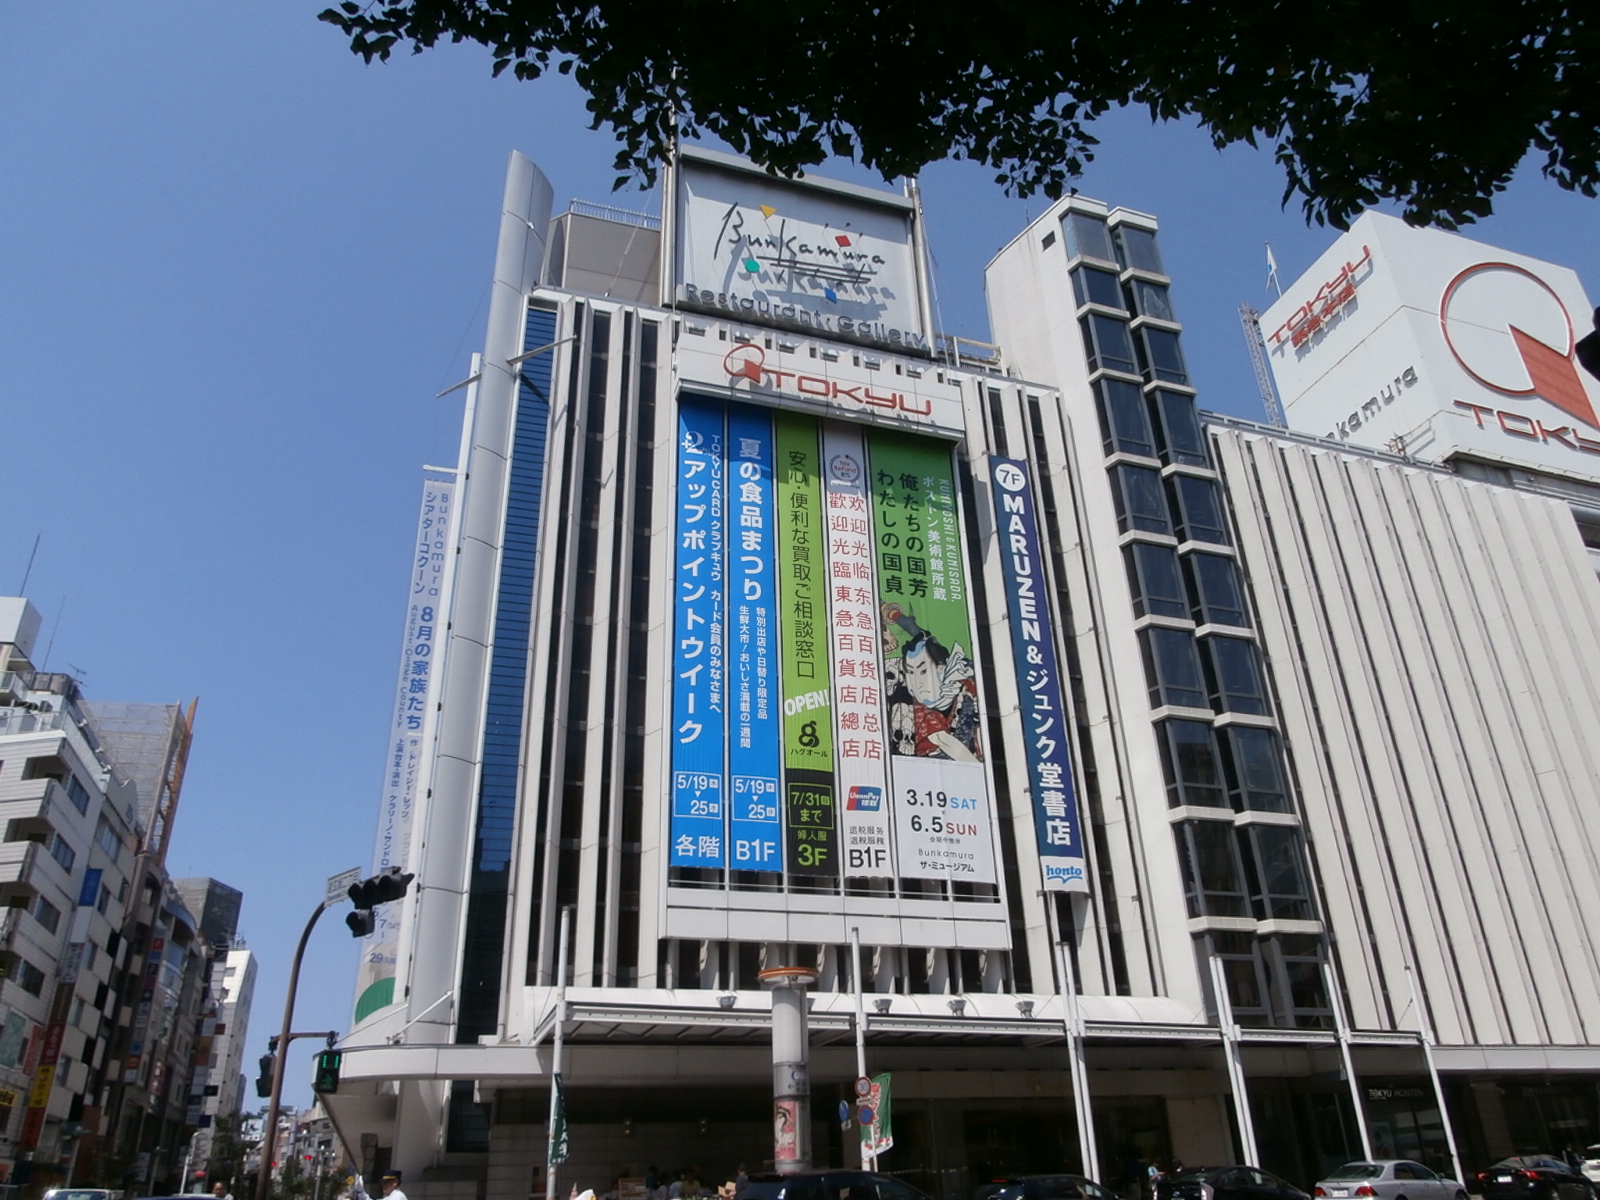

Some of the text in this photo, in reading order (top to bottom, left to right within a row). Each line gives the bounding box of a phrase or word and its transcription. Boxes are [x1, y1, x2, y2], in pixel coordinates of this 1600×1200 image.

[714, 202, 885, 266] Bunkamura
[1267, 245, 1371, 343] TOKYU
[762, 368, 932, 416] TOKYU
[999, 469, 1021, 485] 7F
[739, 438, 764, 602] 夏の食品まつり
[414, 492, 437, 595] シアターコクーン
[877, 469, 905, 596] わたしの国貞
[898, 472, 929, 599] 俺たちの国芳
[922, 476, 947, 602] ボストン美術館所蔵
[428, 493, 449, 597] Bunkamura
[788, 450, 815, 679] 安心・便利な買取ご相談窓口
[406, 606, 434, 731] 8月の家族たち
[756, 607, 769, 720] 特別出店や日替り限定品
[784, 689, 830, 717] OPEN!
[791, 747, 828, 758] ハグオール
[850, 792, 880, 801] UnionPay
[906, 788, 977, 810] 3.19 SAT
[799, 808, 823, 822] まで
[911, 814, 977, 836] 6.5 SUN
[675, 835, 720, 859] 各階
[797, 829, 828, 842] 婦人服
[736, 839, 775, 862] B1F
[797, 844, 828, 867] 3F
[849, 846, 886, 869] B1F
[918, 848, 974, 860] Bunkamura
[919, 860, 975, 873] ザ・ミュージアム
[1046, 865, 1083, 877] honto
[1368, 1088, 1392, 1098] TOKYU
